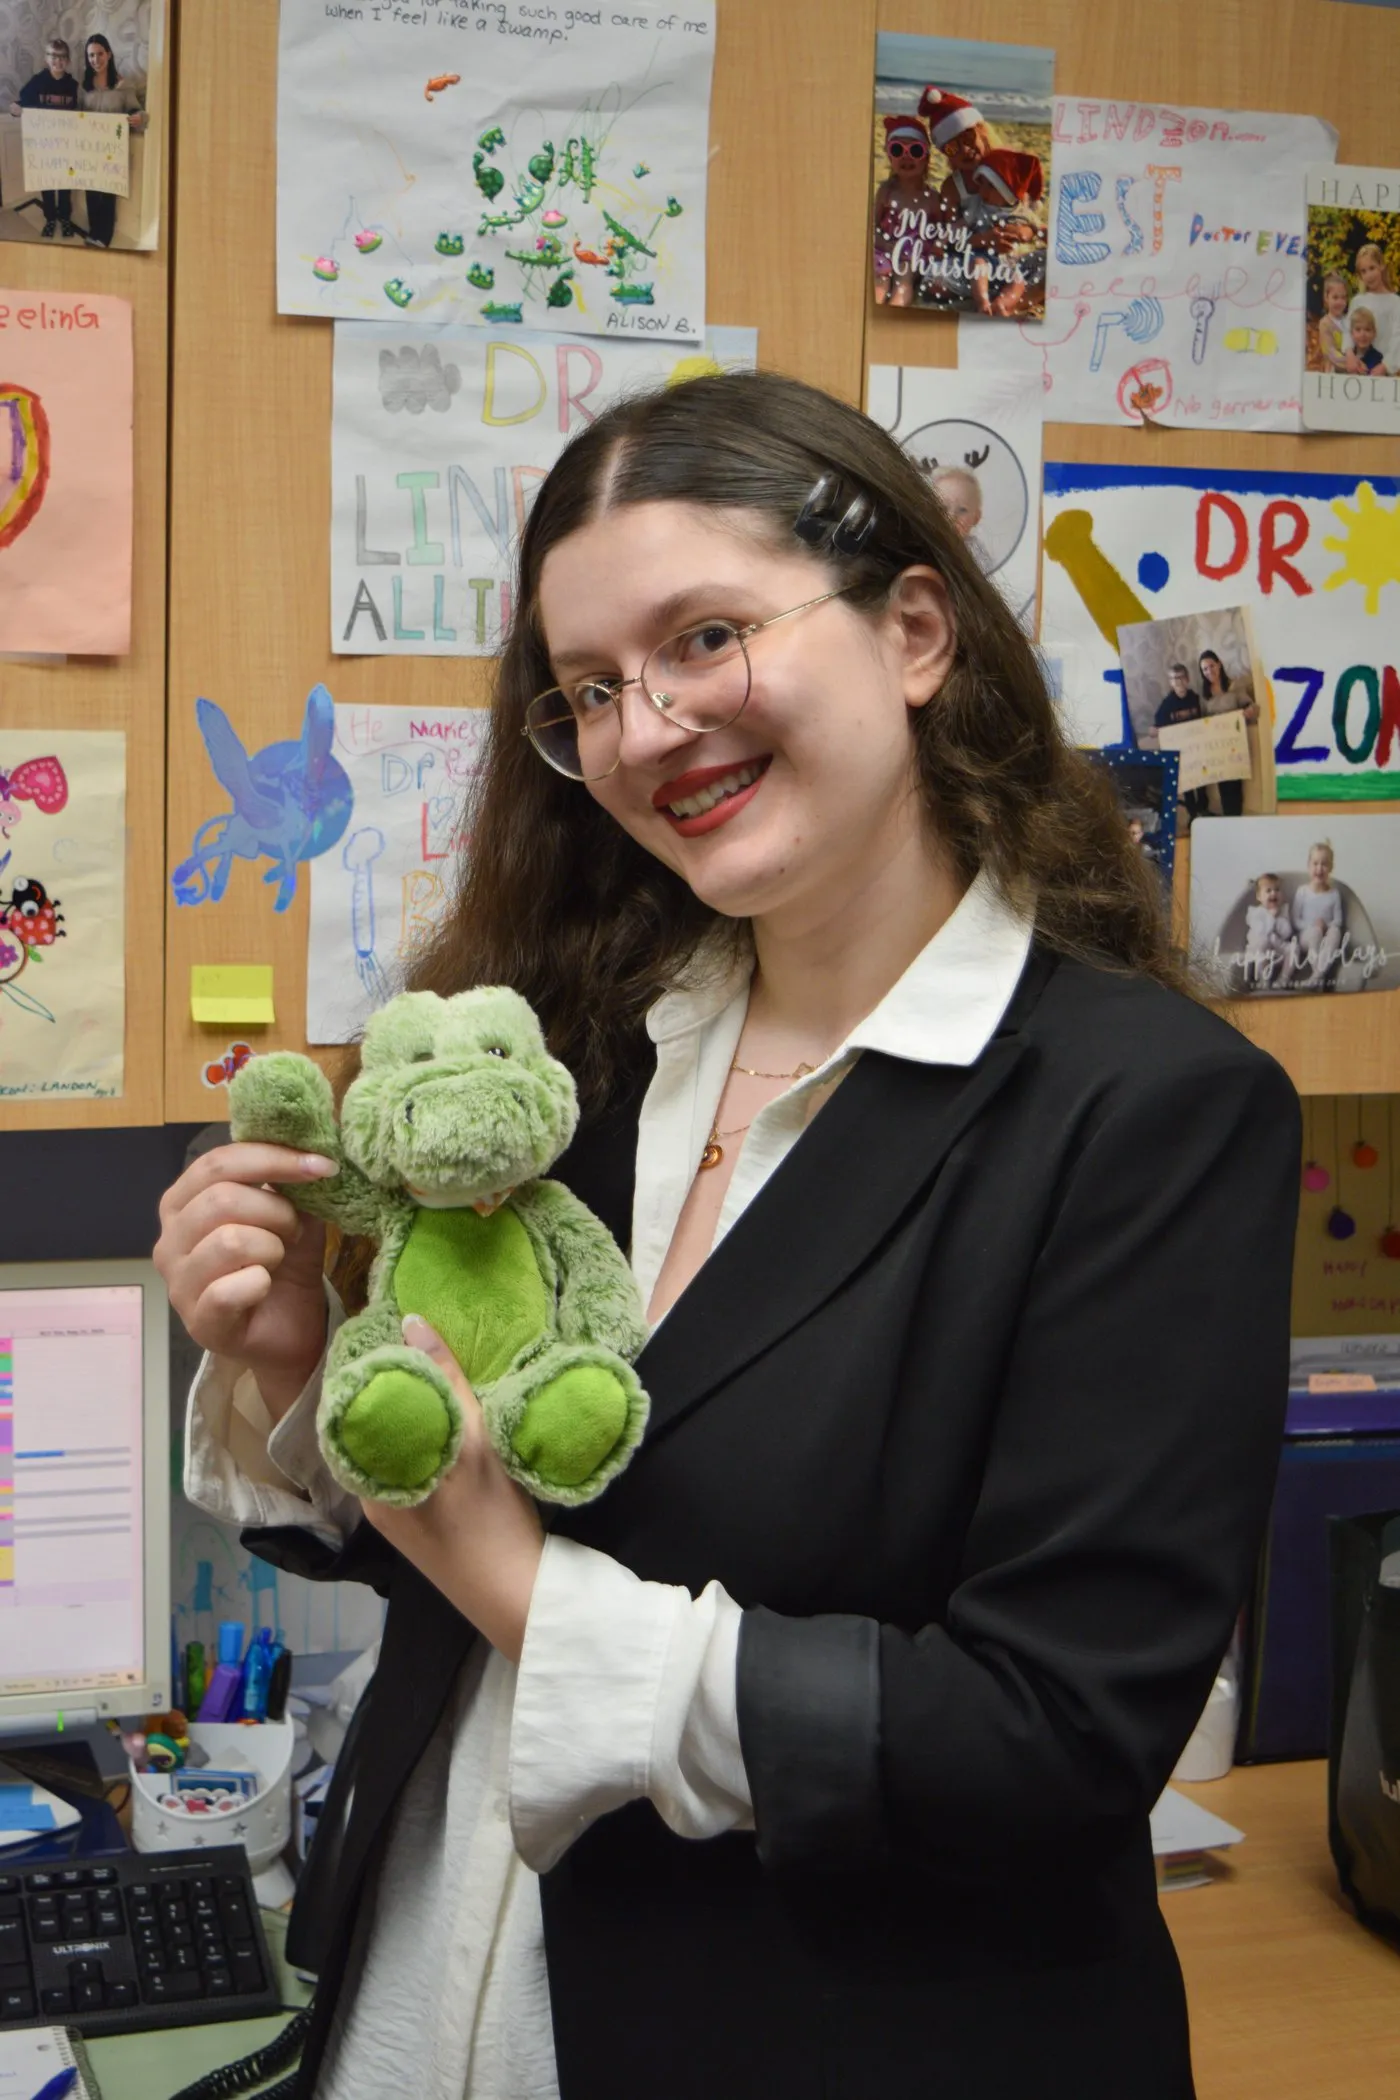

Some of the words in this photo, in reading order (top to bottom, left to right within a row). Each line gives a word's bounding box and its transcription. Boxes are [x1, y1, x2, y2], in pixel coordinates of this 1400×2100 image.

[373, 7, 385, 21] I
[393, 7, 427, 26] feel
[436, 10, 468, 30] like
[475, 18, 488, 33] a
[518, 5, 558, 21] such
[564, 10, 603, 30] good
[611, 14, 650, 29] care
[655, 14, 681, 31] of
[684, 21, 709, 36] me
[1318, 177, 1400, 209] HAP
[894, 208, 972, 254] Merry
[1256, 230, 1308, 258] EVE
[891, 236, 1031, 284] Christmas
[1195, 491, 1314, 597] DR
